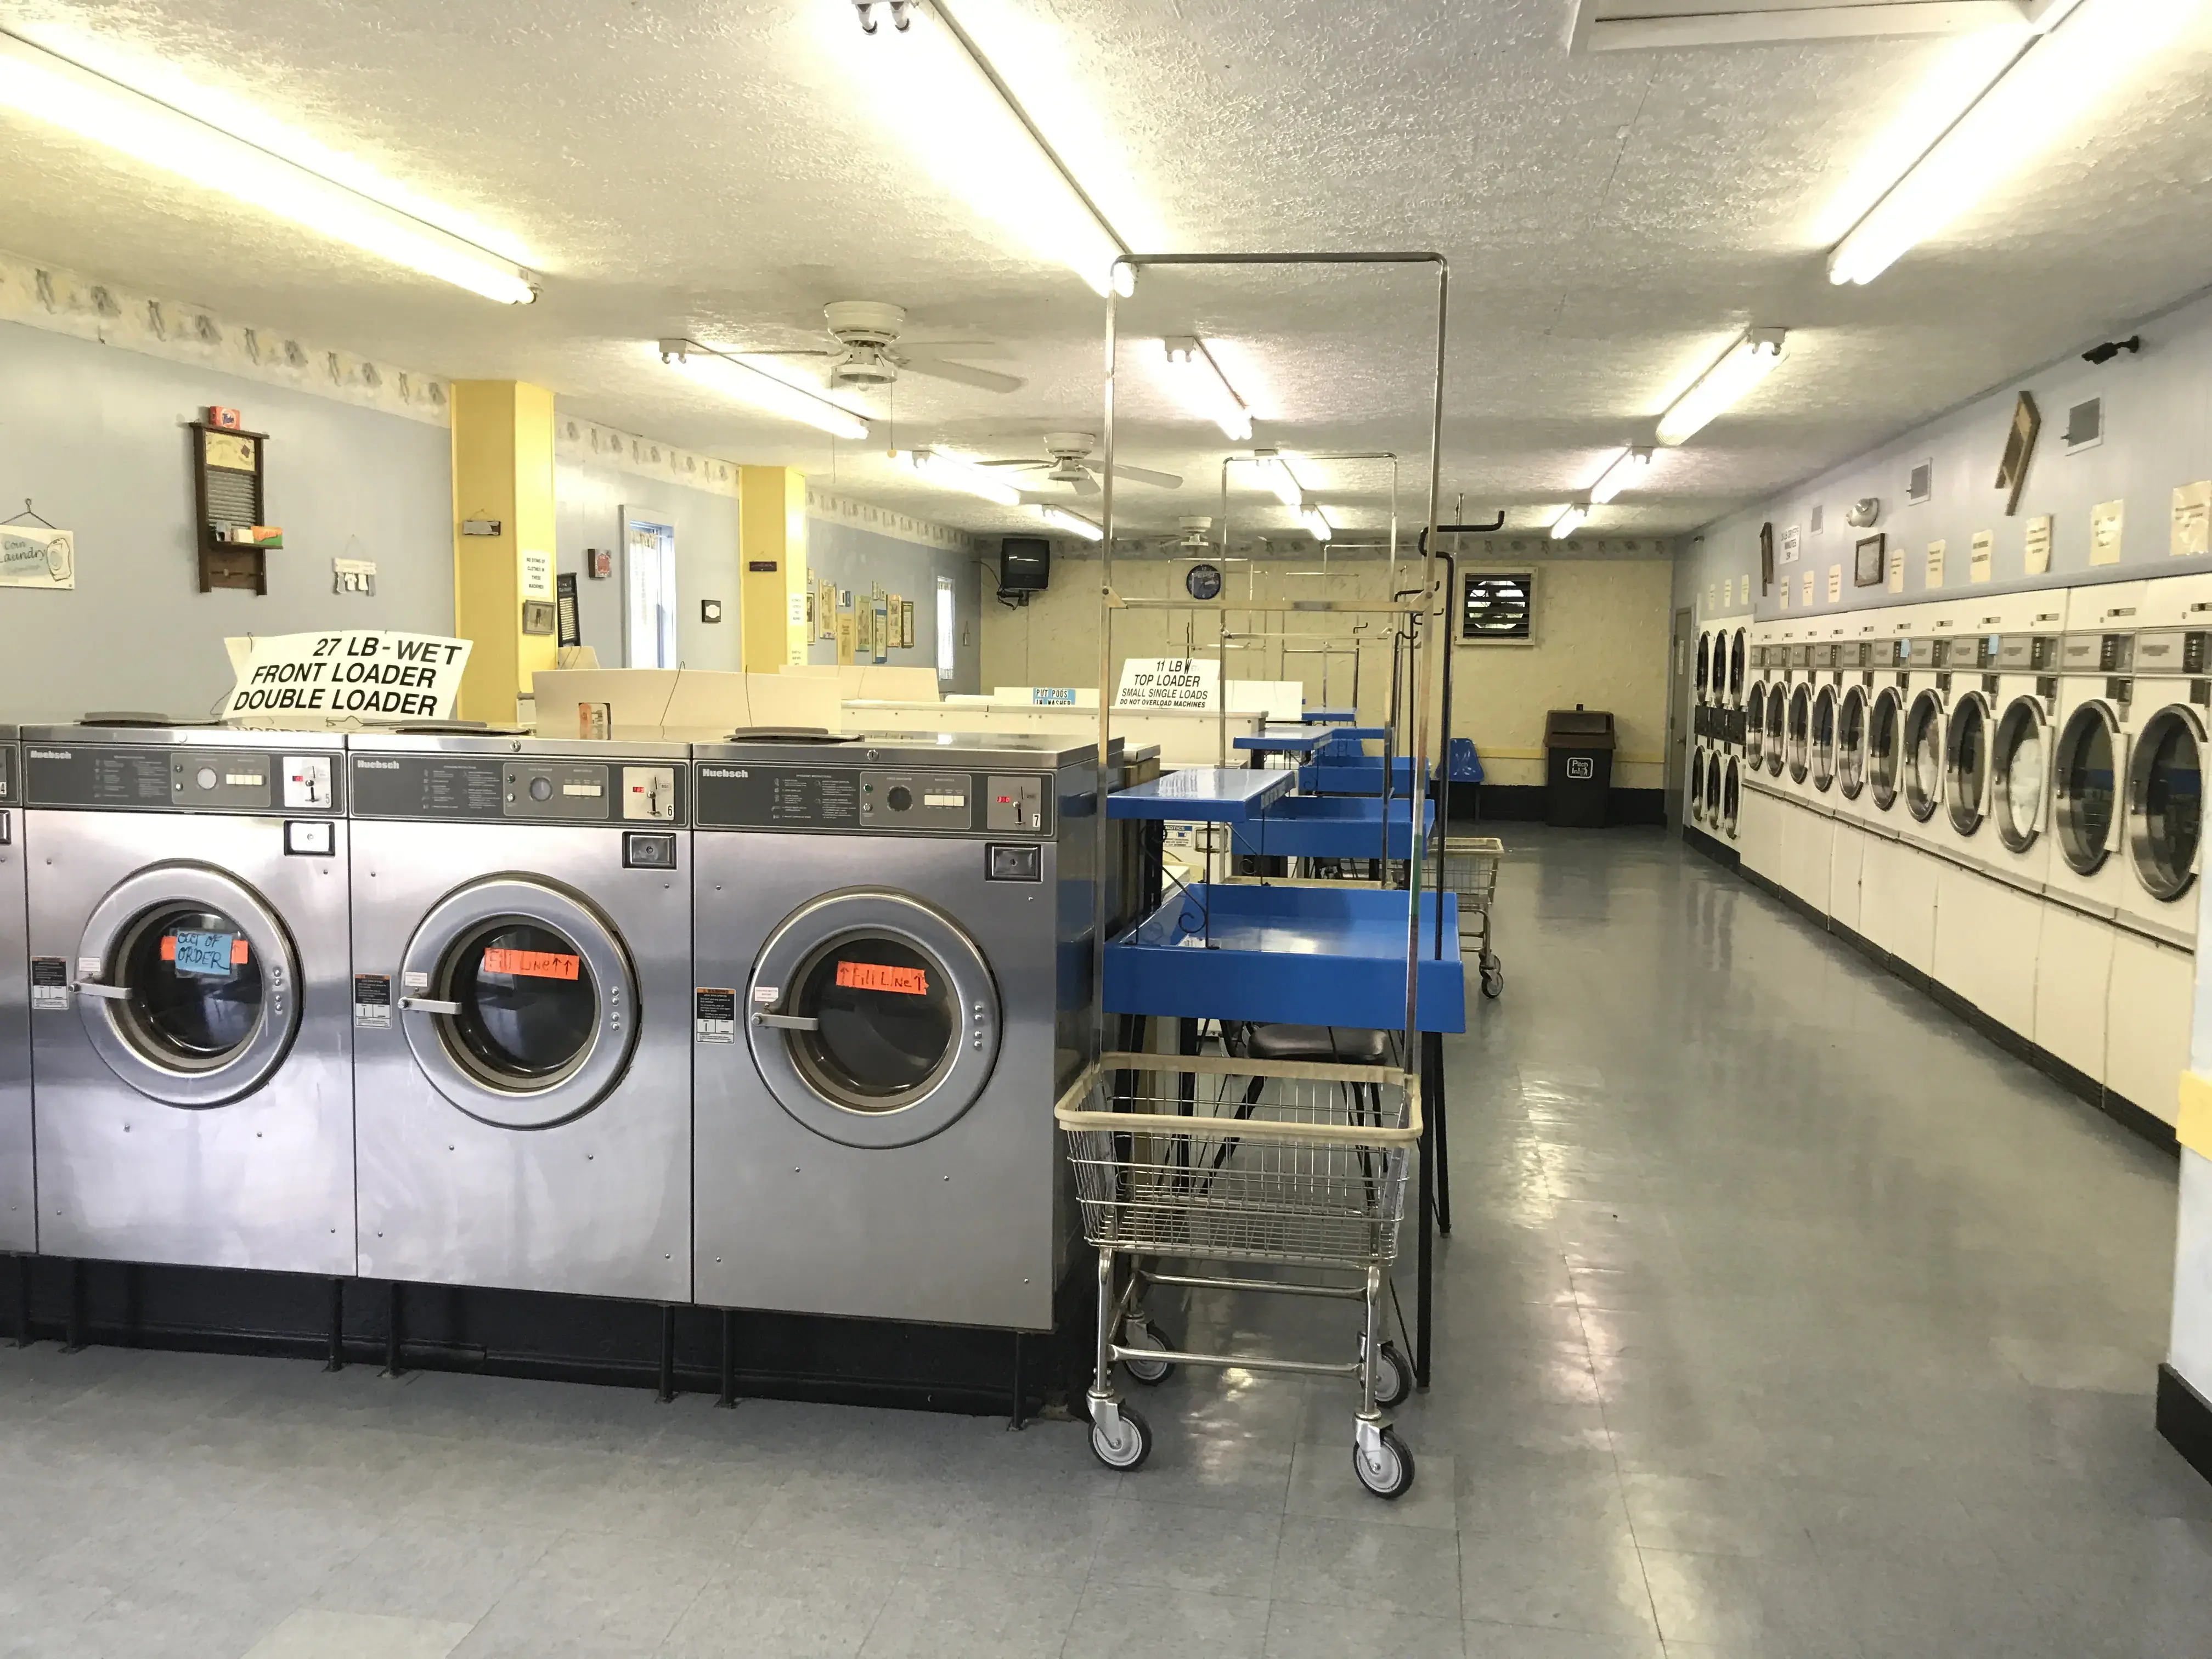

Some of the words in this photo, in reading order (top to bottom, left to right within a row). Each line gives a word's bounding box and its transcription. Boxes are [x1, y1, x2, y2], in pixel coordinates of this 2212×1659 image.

[0, 547, 45, 562] aundry
[313, 638, 342, 656] 27
[1156, 660, 1165, 672] 11
[1169, 661, 1182, 672] LB
[250, 662, 327, 685] FRONT
[331, 662, 437, 689] LOADER
[1134, 674, 1154, 686] TOP
[1156, 674, 1200, 687] LOADER
[1052, 690, 1068, 698] PODS
[1122, 688, 1146, 697] SMALL
[1148, 689, 1177, 698] SINGLE
[1180, 690, 1208, 699] LOADS
[233, 689, 325, 711] DOUBLE
[331, 689, 438, 716] LOADER
[358, 760, 399, 769] Huebsch
[702, 768, 748, 778] Huebsch
[325, 793, 330, 804] 5
[668, 805, 673, 816] 6
[1034, 815, 1039, 826] 7
[205, 934, 223, 947] OF
[178, 946, 230, 970] ORDER
